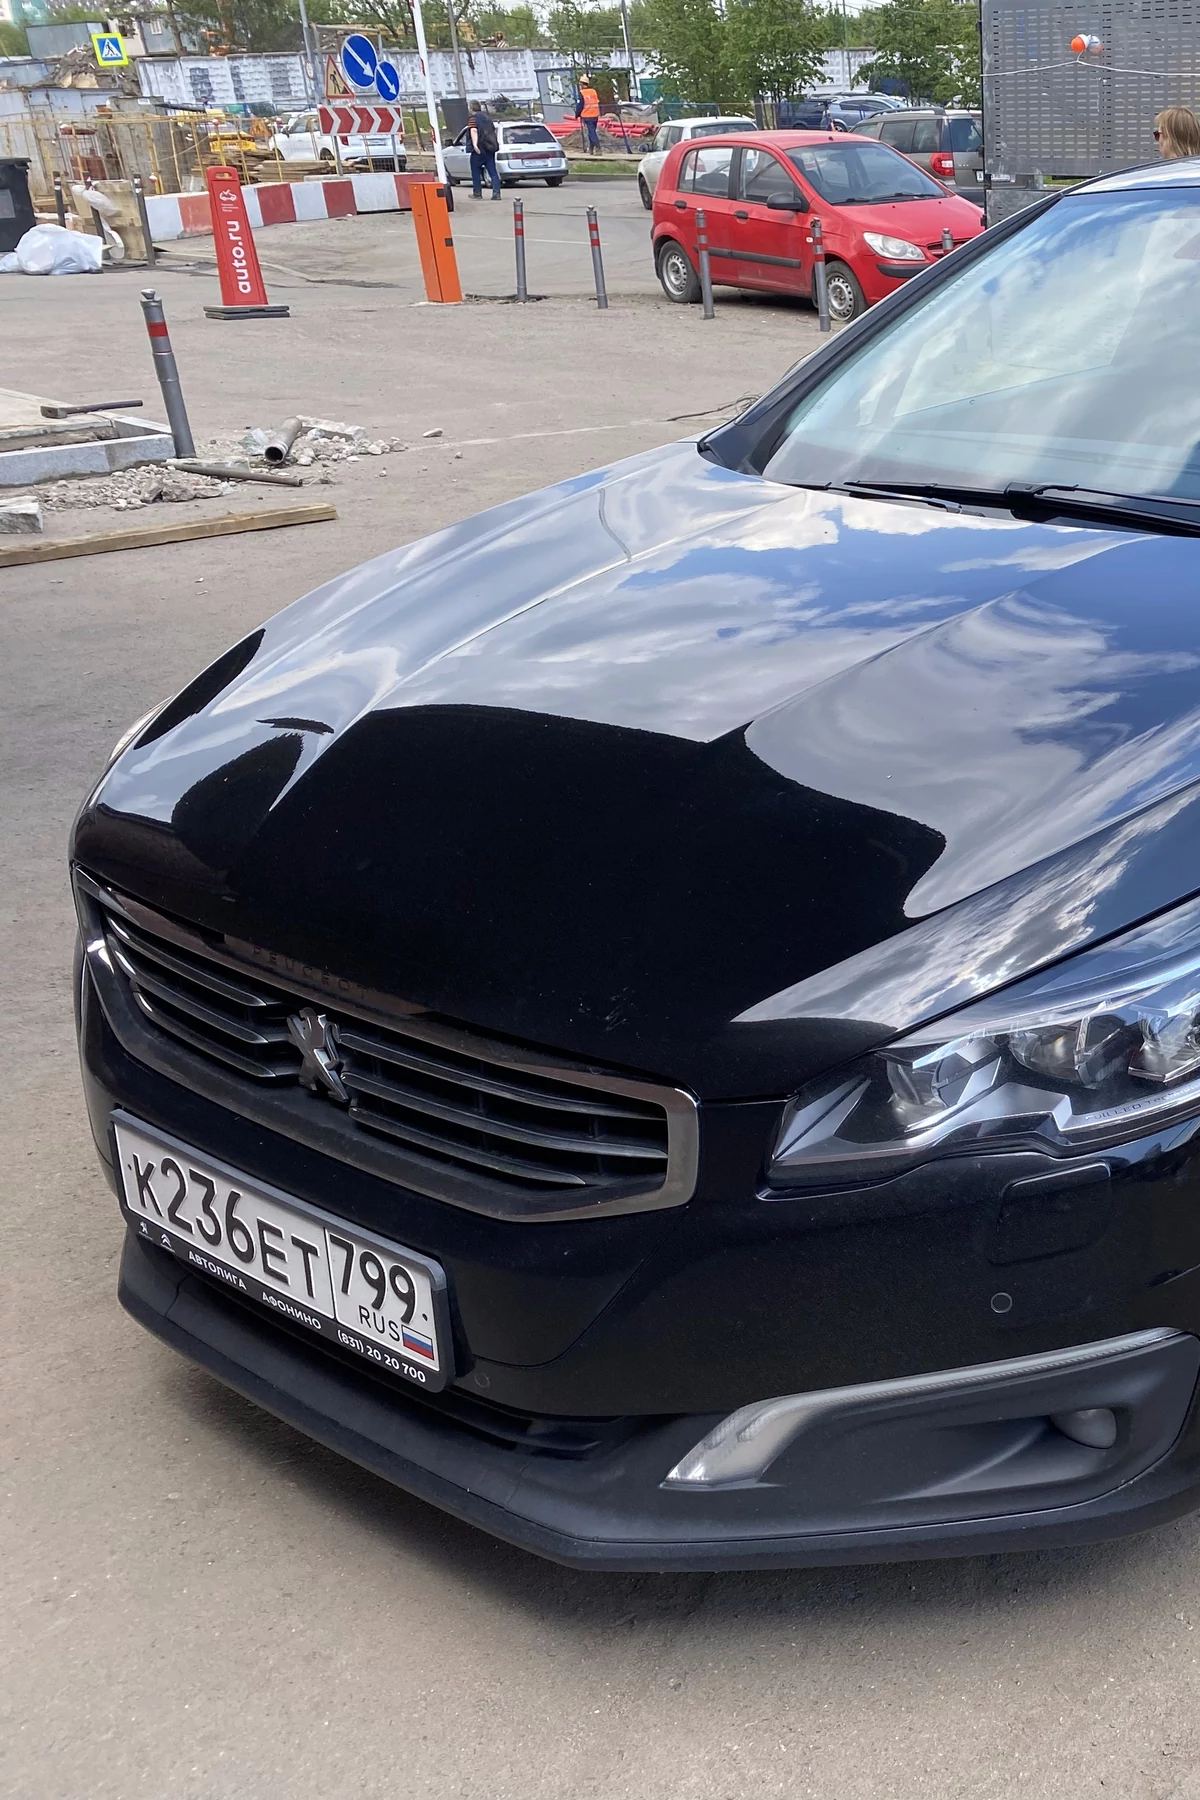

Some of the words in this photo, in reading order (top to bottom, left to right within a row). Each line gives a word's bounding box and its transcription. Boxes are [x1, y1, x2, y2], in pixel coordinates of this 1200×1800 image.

[226, 220, 252, 294] auto.ru
[188, 1250, 247, 1291] АВТОЛИГА
[262, 1291, 322, 1330] АФОНИНО
[337, 1329, 365, 1354] (831)
[366, 1345, 382, 1361] 20
[384, 1354, 400, 1370] 20
[402, 1362, 426, 1384] 700
[330, 1235, 419, 1326] 799
[358, 1304, 401, 1342] RUS
